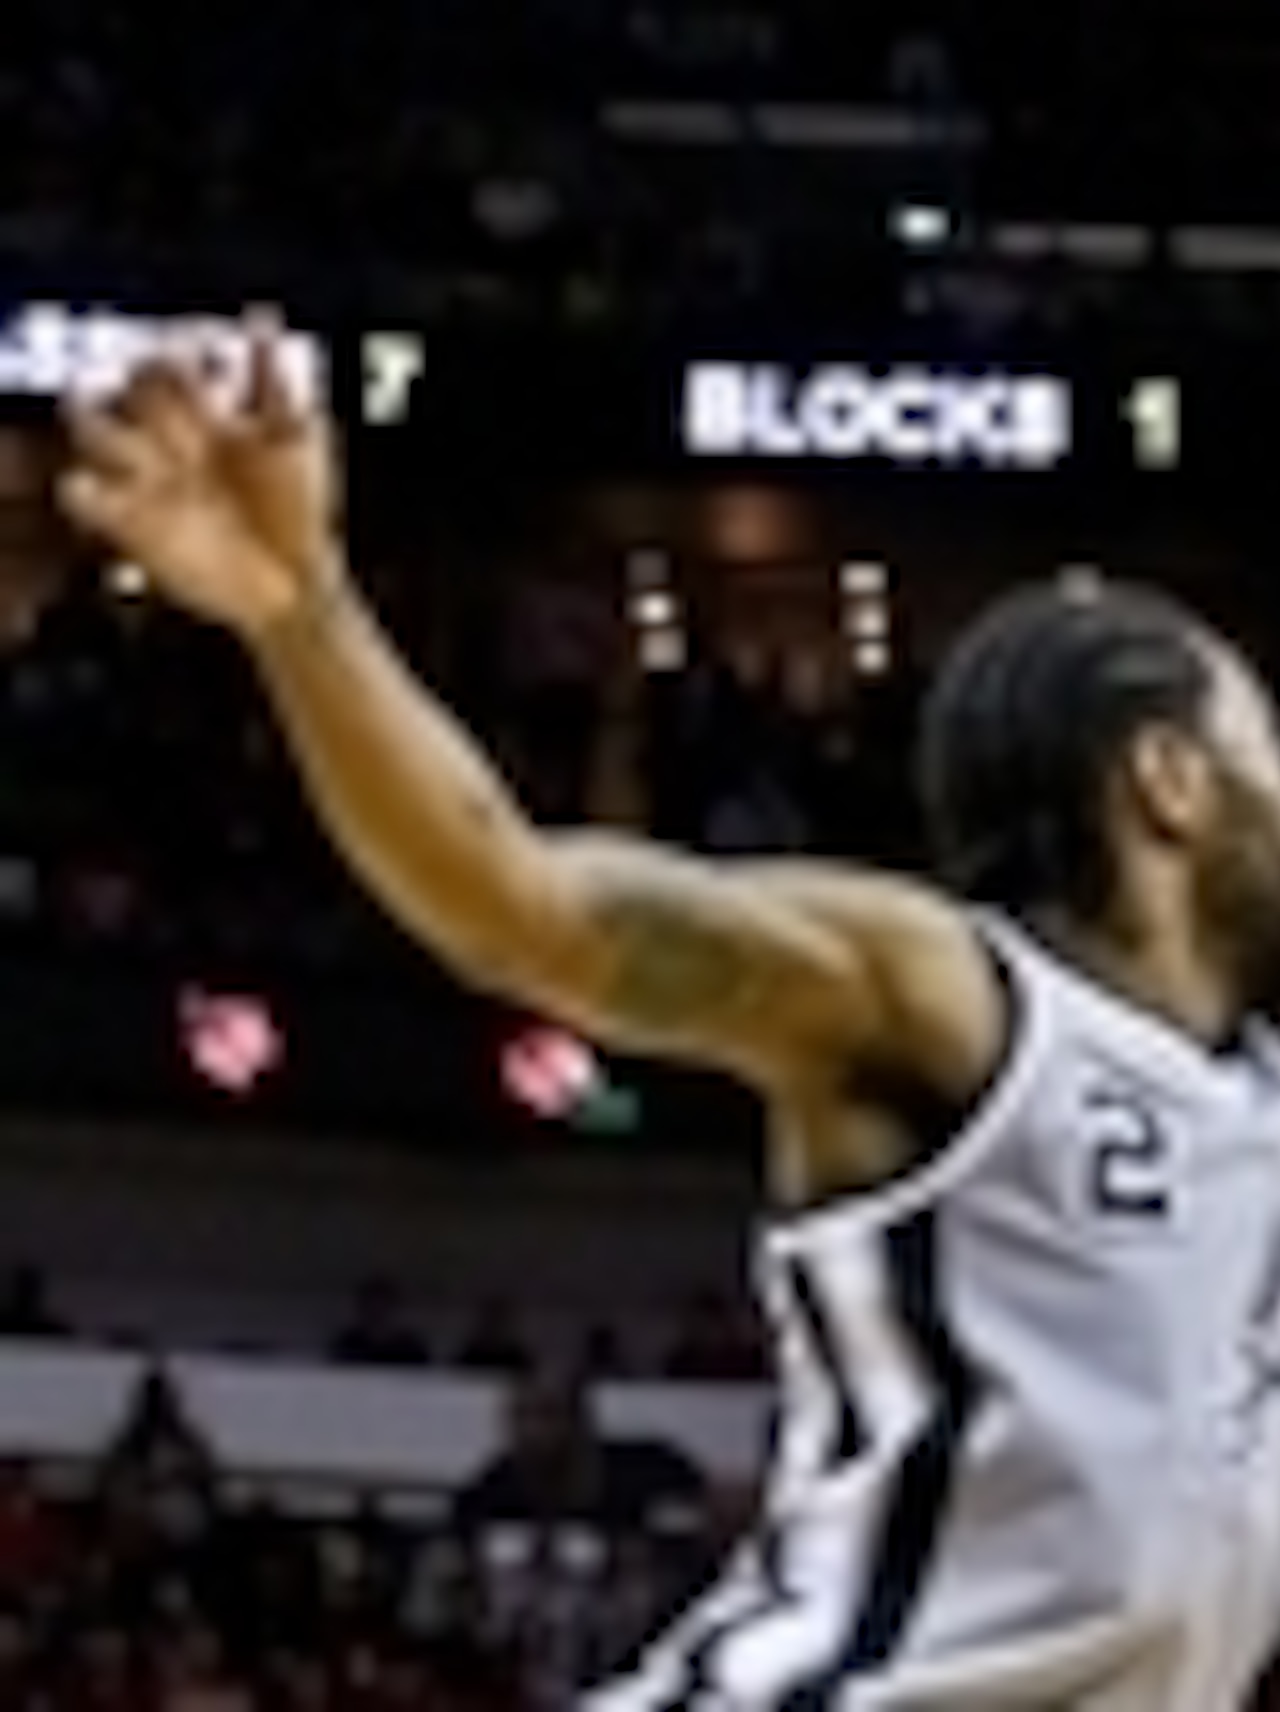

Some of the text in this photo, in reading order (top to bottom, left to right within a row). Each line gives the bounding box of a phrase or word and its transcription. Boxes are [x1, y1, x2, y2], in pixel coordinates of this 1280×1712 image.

[362, 333, 421, 423] 7
[684, 361, 1180, 467] BLOCKS 1
[1084, 1092, 1171, 1219] 2
